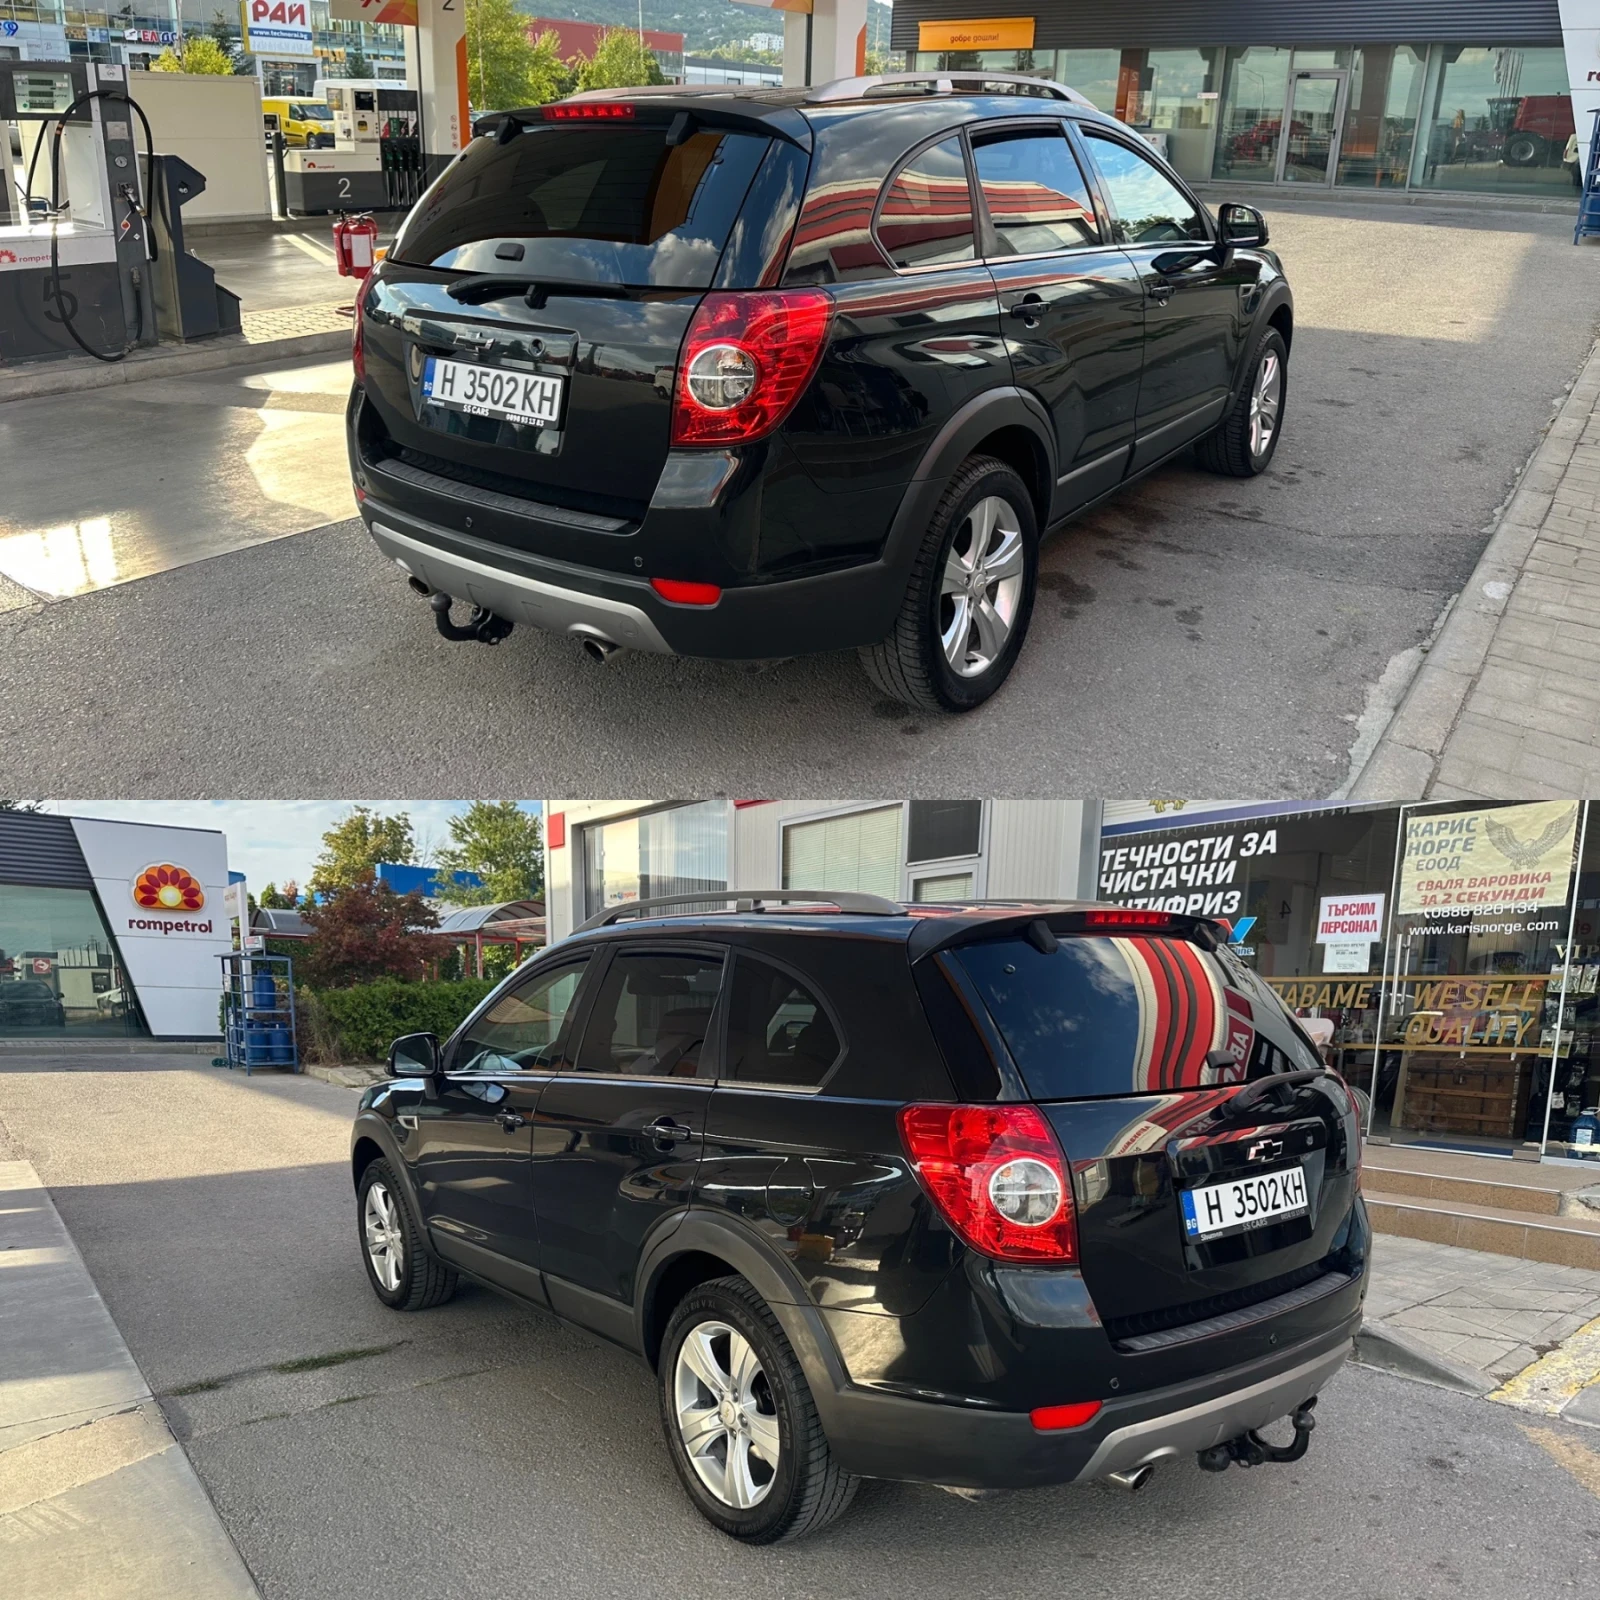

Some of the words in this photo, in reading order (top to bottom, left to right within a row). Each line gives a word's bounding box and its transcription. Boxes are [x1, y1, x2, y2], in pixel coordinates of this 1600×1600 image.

[252, 0, 306, 26] РАЙ
[252, 29, 309, 40] www.technorai.bg
[950, 34, 971, 44] добре
[973, 33, 1000, 44] дошли!
[338, 178, 352, 198] 2
[42, 273, 79, 323] 5
[423, 381, 433, 391] BG
[440, 364, 456, 396] H
[464, 369, 557, 416] 3502KH
[471, 405, 490, 417] CARS
[1407, 817, 1479, 838] КАРИС
[1101, 835, 1234, 872] ТЕЧНОСТИ
[1239, 829, 1278, 857] ЗА
[1406, 836, 1477, 857] НОРГЕ
[1415, 855, 1462, 872] ЕООД
[1100, 860, 1238, 895] ЧИСТАЧКИ
[1416, 878, 1465, 892] СВАЛЯ
[1467, 871, 1552, 889] ВАРОВИКА
[1107, 890, 1242, 915] ТИФРИЗ
[1420, 894, 1438, 906] ЗА
[1441, 893, 1453, 904] 2
[1455, 887, 1546, 902] СЕКУНДИ
[1327, 902, 1376, 917] ТЪРСИМ
[1430, 904, 1471, 919] 0886
[1473, 902, 1504, 916] 820
[1509, 901, 1539, 915] 134
[128, 918, 213, 935] rompetrol
[1320, 919, 1378, 934] ПЕРСОНАЛ
[1409, 921, 1559, 936] www.karisnorge.com
[1413, 983, 1459, 1010] WE
[1462, 983, 1536, 1012] SELL
[1405, 1014, 1536, 1046] QUALITY
[1205, 1189, 1223, 1225] H
[1232, 1171, 1305, 1218] 3502KH
[1186, 1218, 1197, 1230] BG
[1251, 1218, 1268, 1228] CARS
